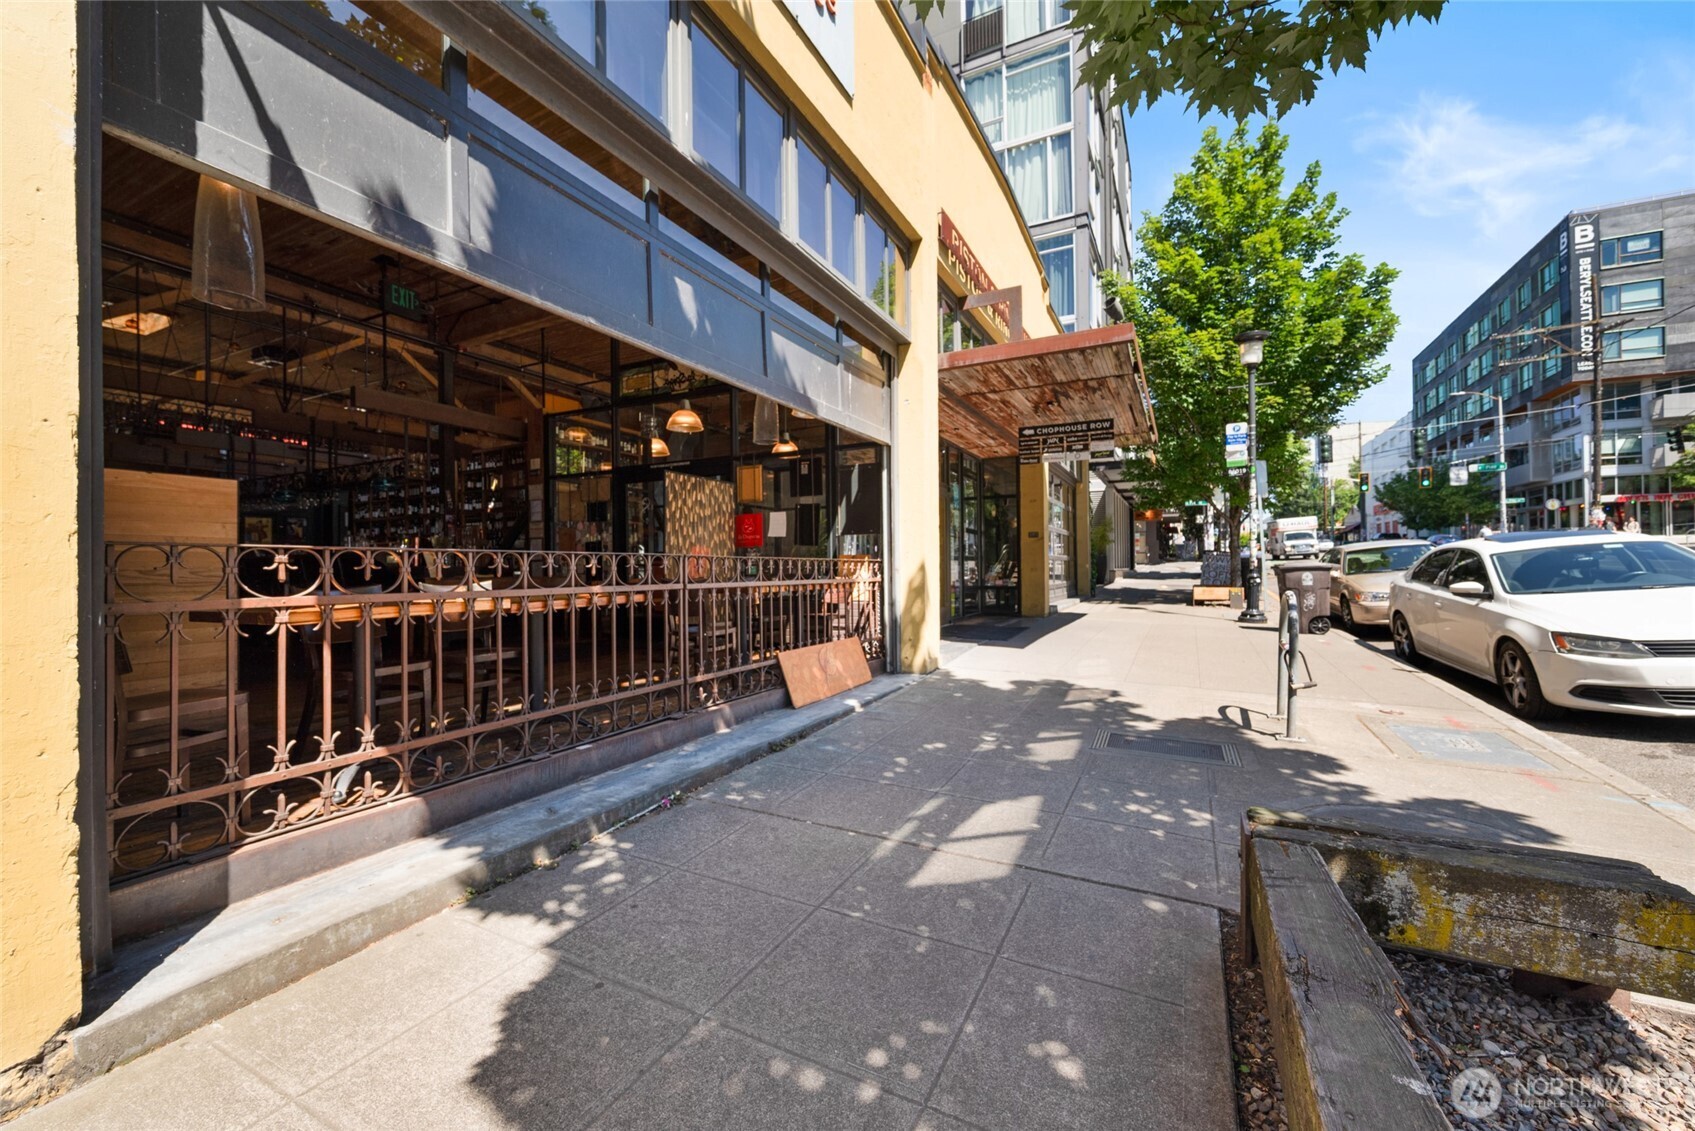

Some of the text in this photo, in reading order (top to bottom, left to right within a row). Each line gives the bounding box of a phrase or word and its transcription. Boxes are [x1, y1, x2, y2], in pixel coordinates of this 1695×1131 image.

[391, 283, 416, 310] EXIT
[1036, 421, 1111, 435] CHOPHOUSE ROW
